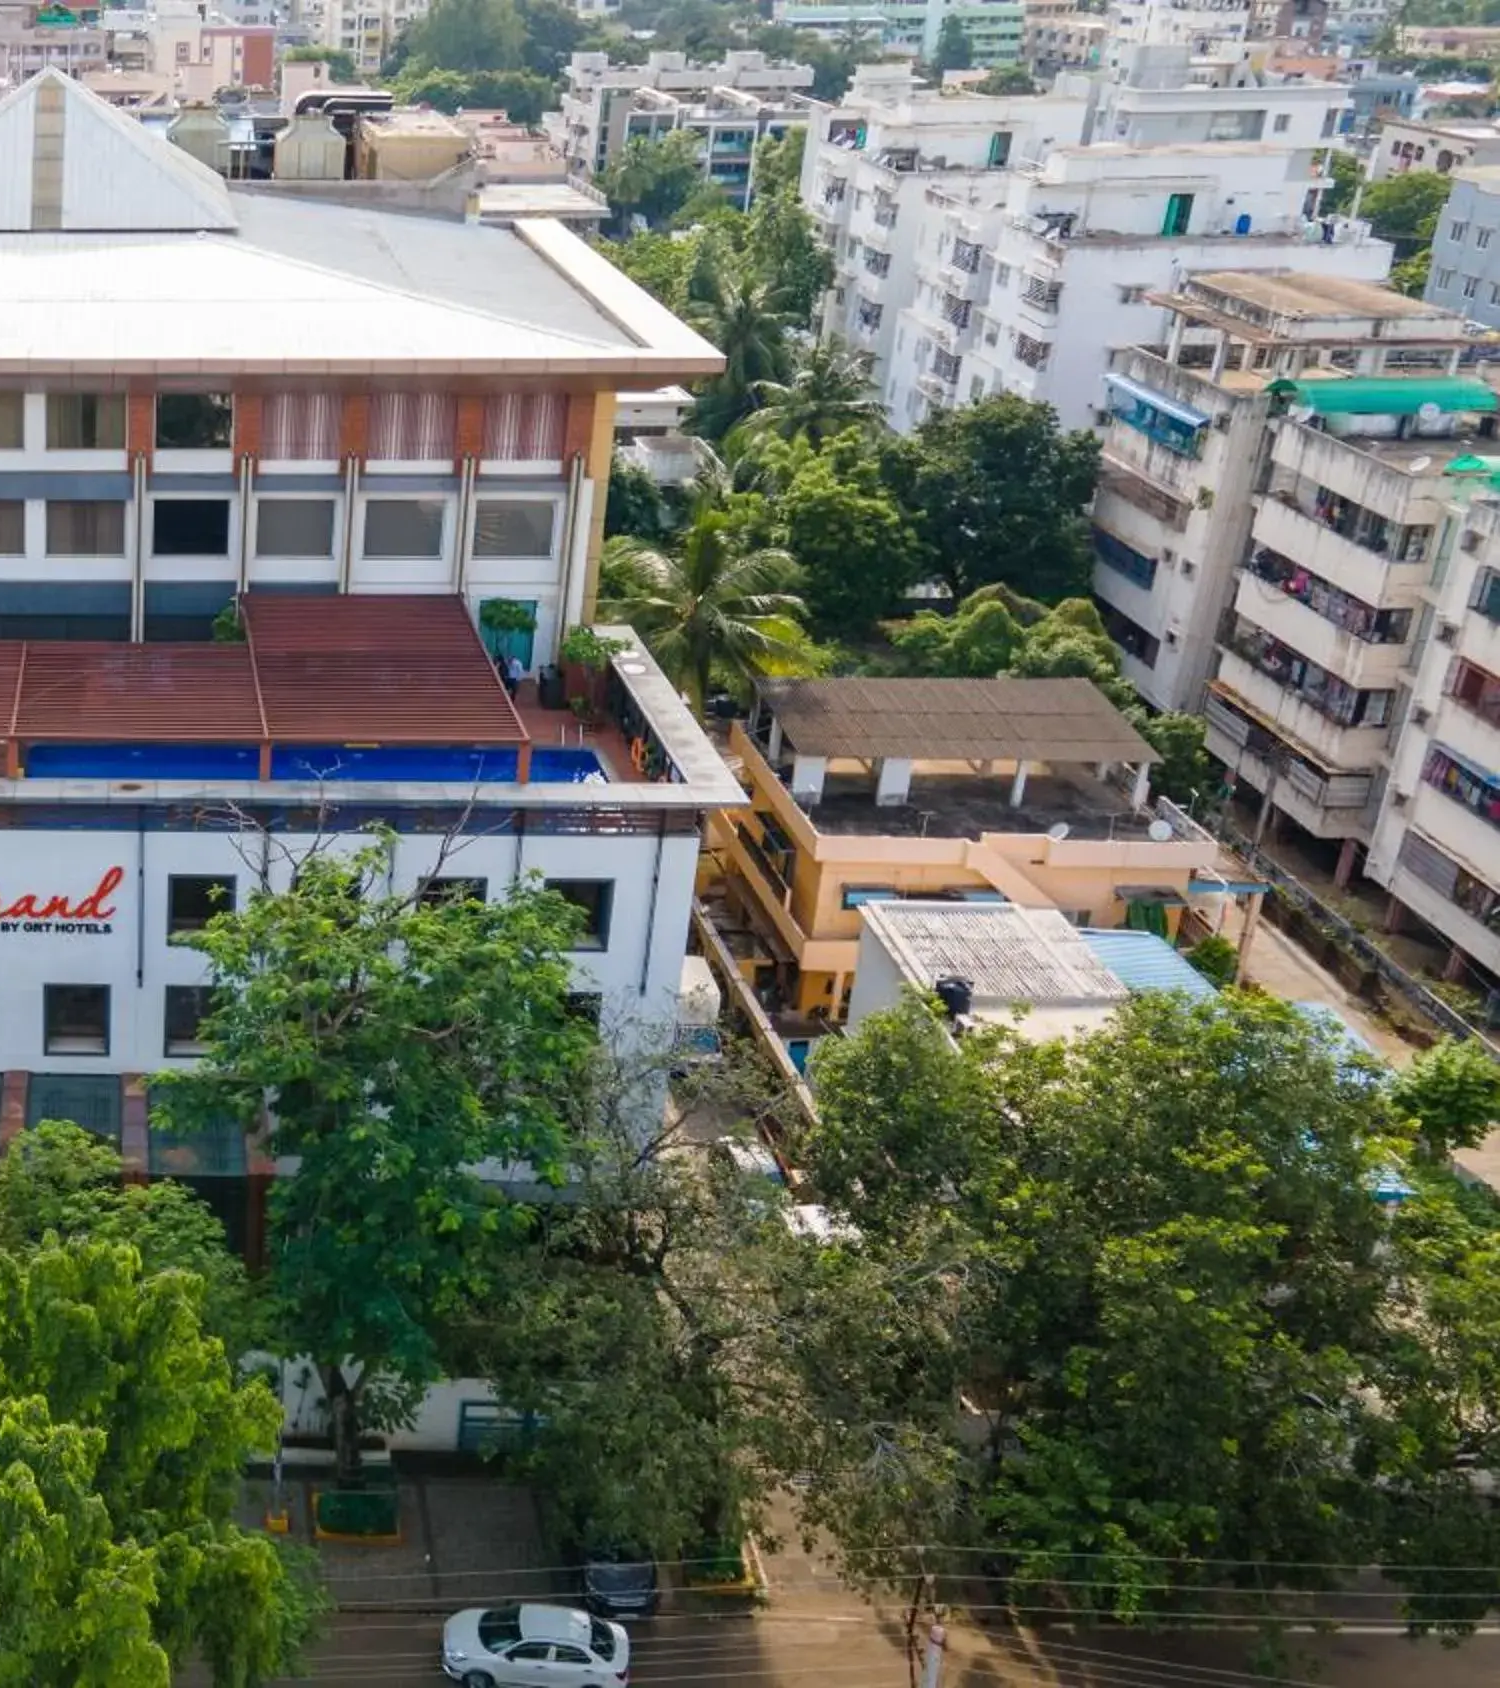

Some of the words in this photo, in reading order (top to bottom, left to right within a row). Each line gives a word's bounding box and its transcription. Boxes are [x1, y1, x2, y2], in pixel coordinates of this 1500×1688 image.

[0, 922, 20, 933] BY
[23, 922, 52, 933] GRT
[55, 923, 113, 935] HOTELS
